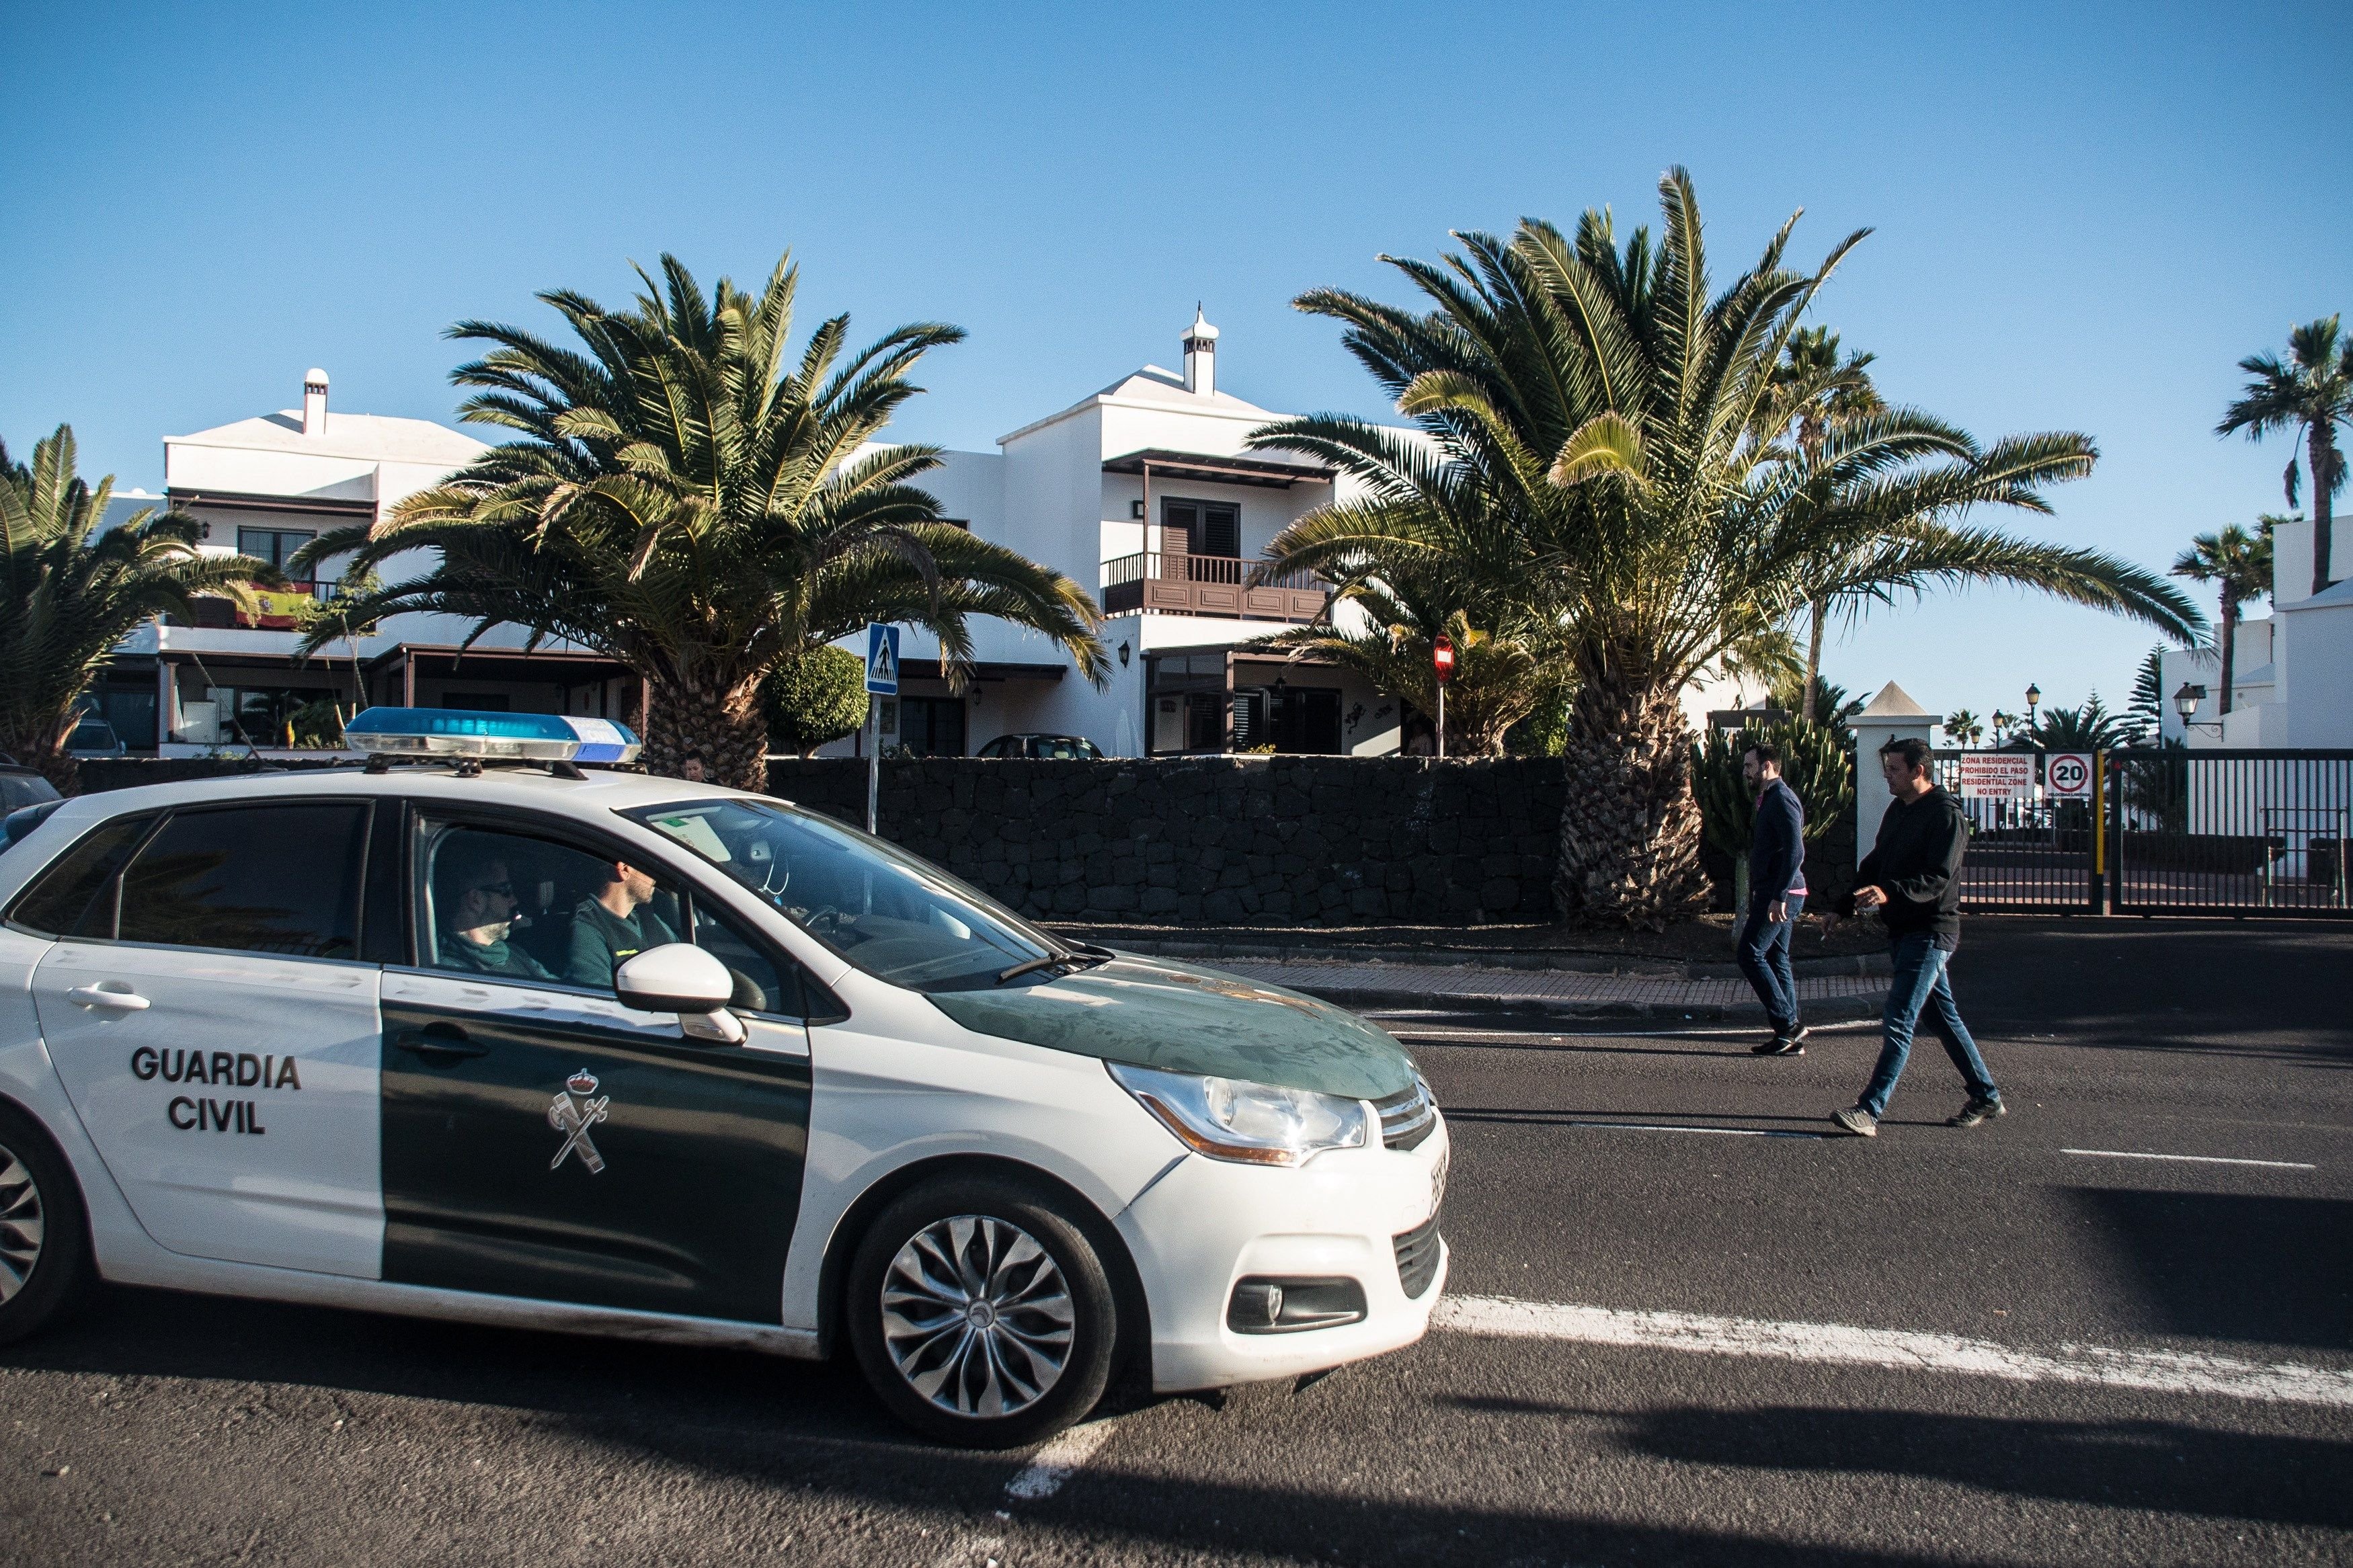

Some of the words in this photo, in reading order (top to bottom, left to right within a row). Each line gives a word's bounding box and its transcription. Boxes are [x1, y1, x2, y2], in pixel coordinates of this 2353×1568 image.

[2056, 766, 2083, 781] 20
[131, 1046, 302, 1089] GUARDIA
[169, 1096, 266, 1134] CIVIL
